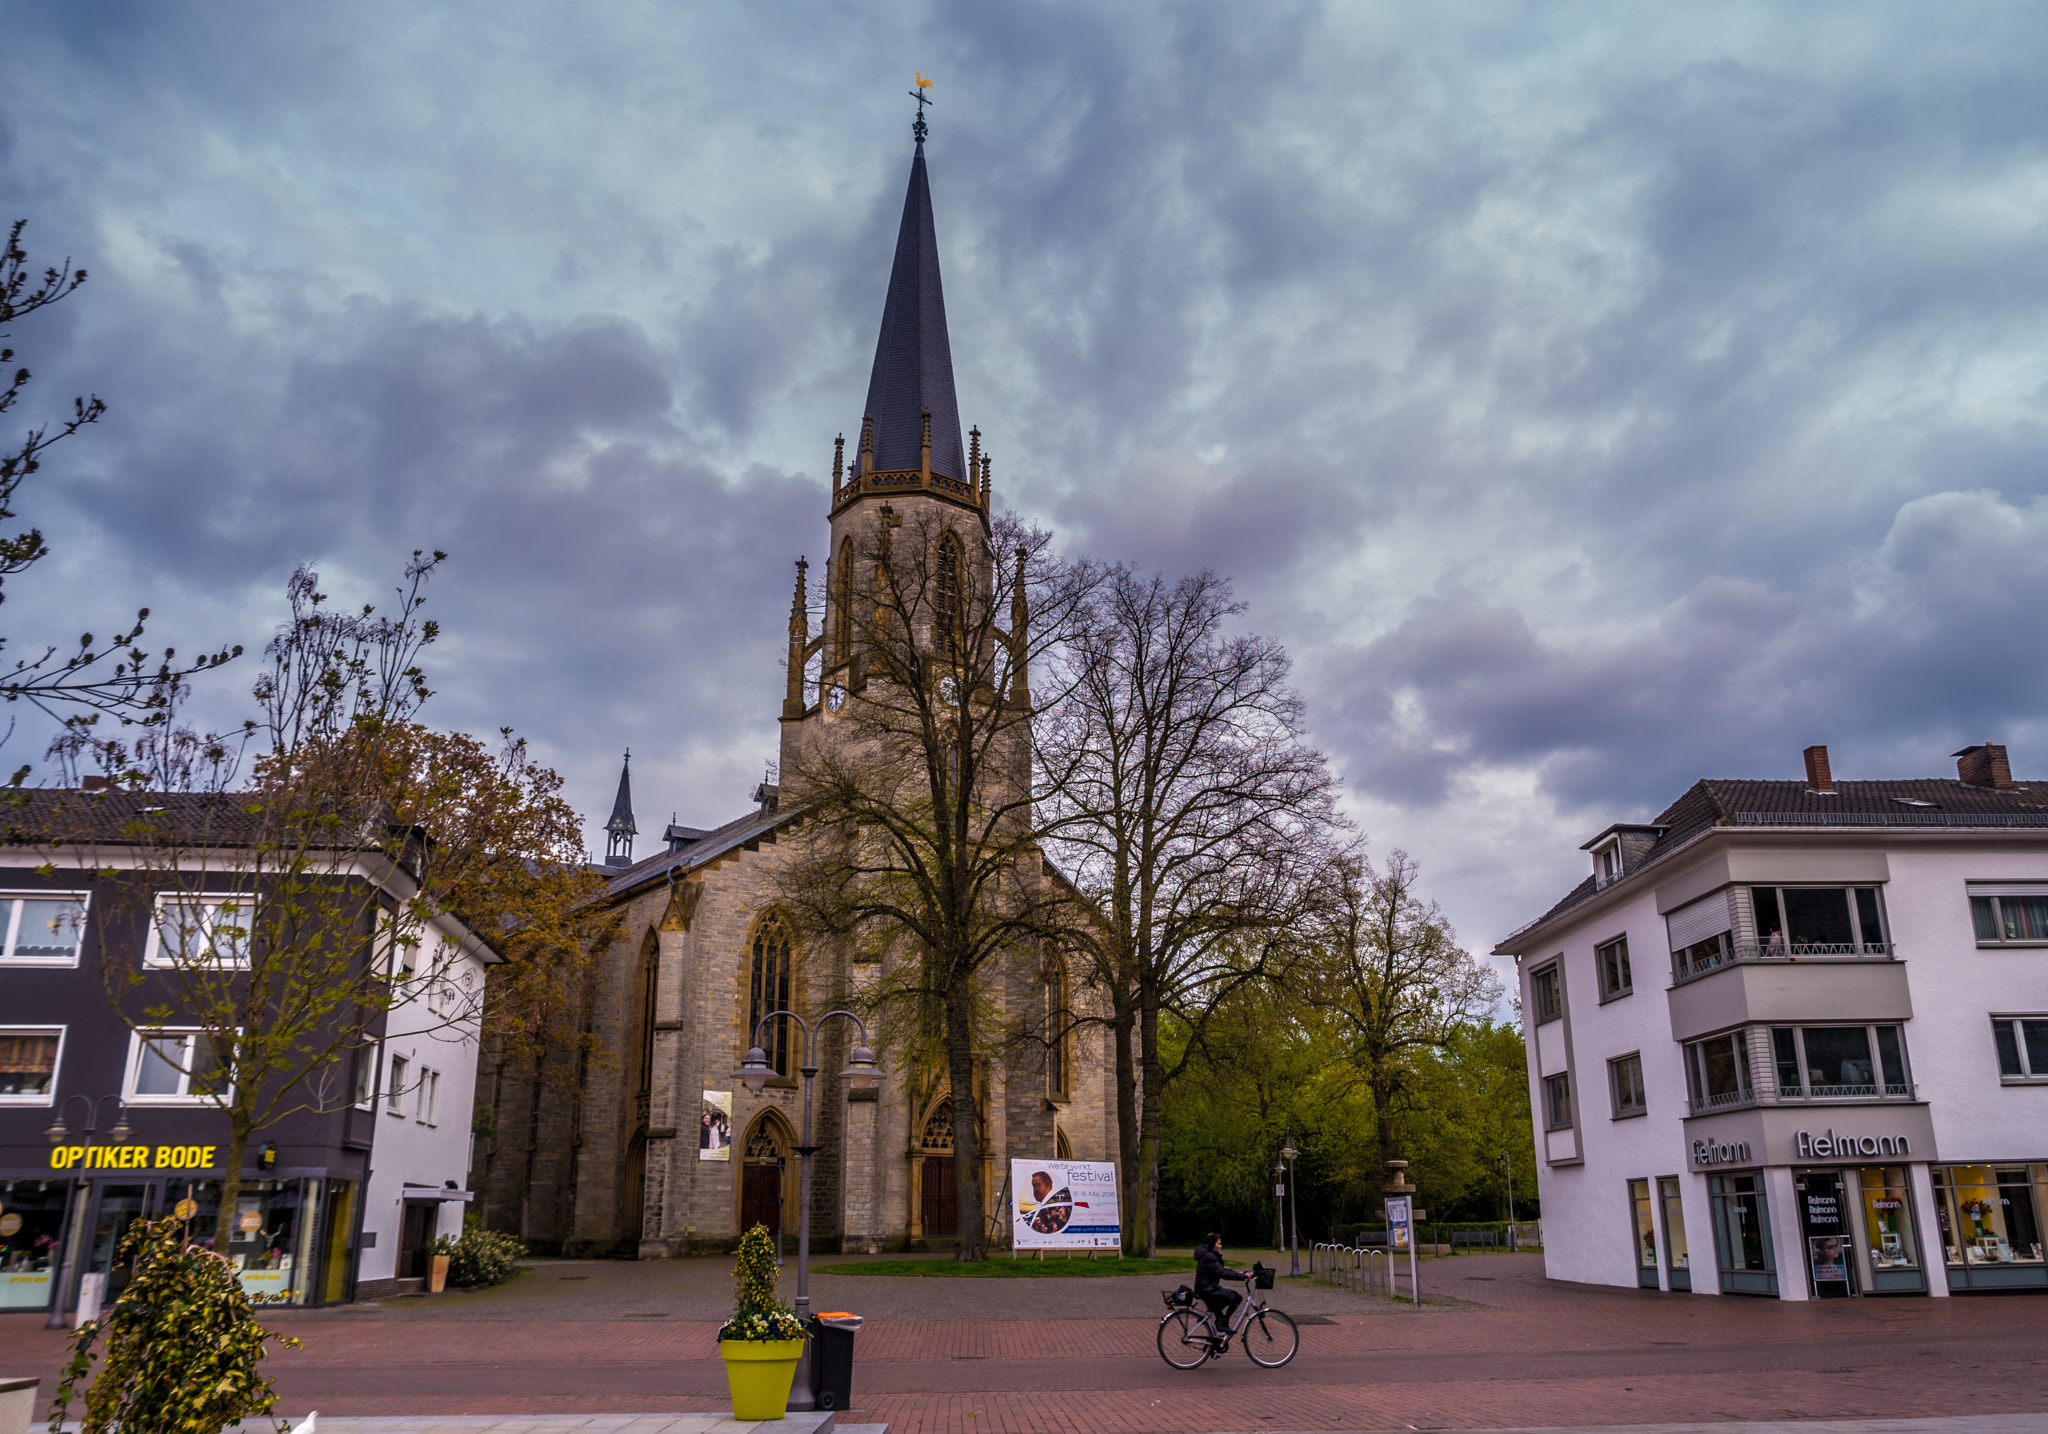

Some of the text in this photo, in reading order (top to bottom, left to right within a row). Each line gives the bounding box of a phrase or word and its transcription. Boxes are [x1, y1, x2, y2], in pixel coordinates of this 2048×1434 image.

[50, 1145, 217, 1169] OPTIKER BODE
[1067, 1169, 1114, 1186] festival
